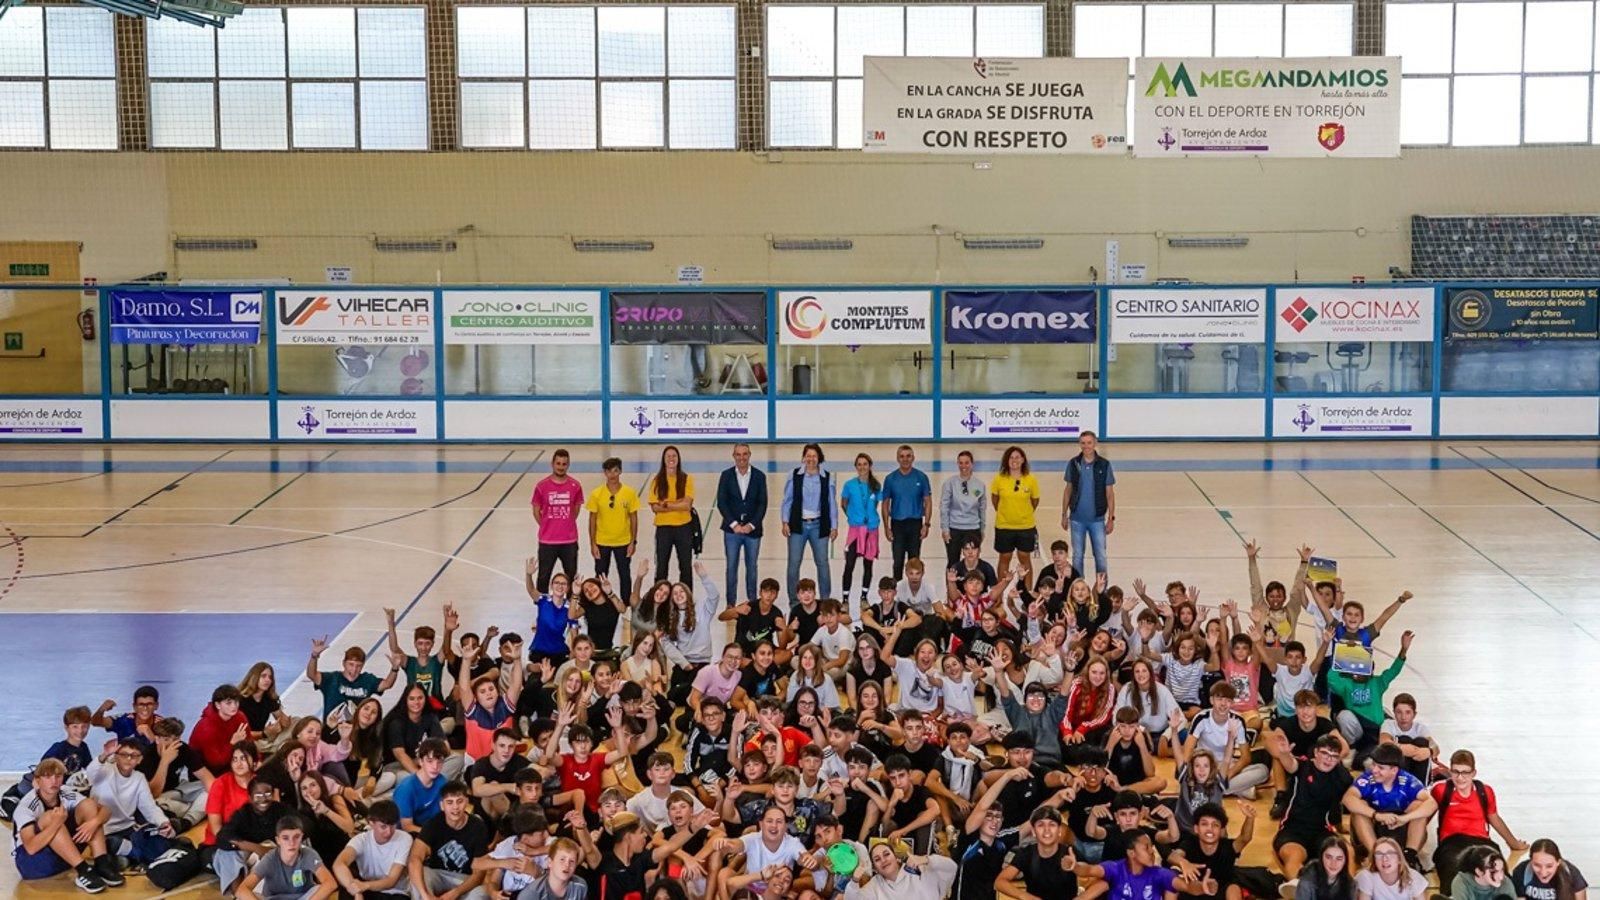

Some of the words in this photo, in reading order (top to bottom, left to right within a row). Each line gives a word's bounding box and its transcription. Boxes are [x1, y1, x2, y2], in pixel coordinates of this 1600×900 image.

[1200, 69, 1388, 88] MEGAANDAMIOS
[907, 85, 924, 96] EN
[927, 85, 944, 96] LA
[947, 85, 1001, 96] CANCHA
[1005, 83, 1025, 97] SE
[1028, 83, 1084, 97] JUEGA
[897, 108, 914, 120] EN
[917, 108, 933, 120] LA
[937, 108, 982, 120] GRADA
[987, 105, 1006, 120] SE
[1010, 105, 1094, 120] DISFRUTA
[1154, 105, 1186, 118] CON
[1189, 105, 1204, 118] EL
[1208, 105, 1270, 118] DEPORTE
[1274, 105, 1292, 118] EN
[1297, 103, 1366, 119] TORREJÓN
[922, 130, 968, 148] CON
[974, 130, 1068, 148] RESPETO
[1182, 128, 1221, 140] Torrejón
[1224, 128, 1236, 138] de
[1239, 128, 1268, 138] Ardoz
[1494, 290, 1549, 298] DESATASCOS
[1550, 290, 1585, 298] EUROPA
[120, 298, 185, 318] Damo,
[190, 298, 224, 316] S.L.
[337, 298, 429, 312] VIHECAR
[848, 306, 908, 317] MONTAJES
[1116, 300, 1178, 314] CENTRO
[1182, 298, 1260, 313] SANITARIO
[1321, 300, 1420, 319] KOCINAX
[338, 314, 430, 326] TALLER
[615, 306, 684, 322] GRUPO
[951, 306, 1090, 330] Kromex
[1530, 310, 1541, 318] sin
[460, 318, 514, 326] CENTRO
[518, 318, 586, 326] AUDITIVO
[830, 318, 926, 330] COMPLUTUM
[127, 328, 173, 340] Pinturas
[176, 331, 182, 342] y
[184, 328, 250, 340] Decoración
[0, 408, 33, 420] orrejón
[36, 408, 49, 419] de
[52, 408, 82, 419] Ardoz
[326, 408, 368, 422] Torrejón
[370, 408, 383, 419] de
[386, 408, 417, 419] Ardoz
[658, 409, 700, 422] Torrejón
[702, 409, 715, 419] de
[717, 409, 748, 419] Ardoz
[989, 408, 1031, 420] Torrejón
[1033, 408, 1047, 418] de
[1049, 408, 1080, 418] Ardoz
[1321, 406, 1364, 419] Torrejón
[1365, 406, 1379, 416] de
[1381, 406, 1413, 416] Ardoz
